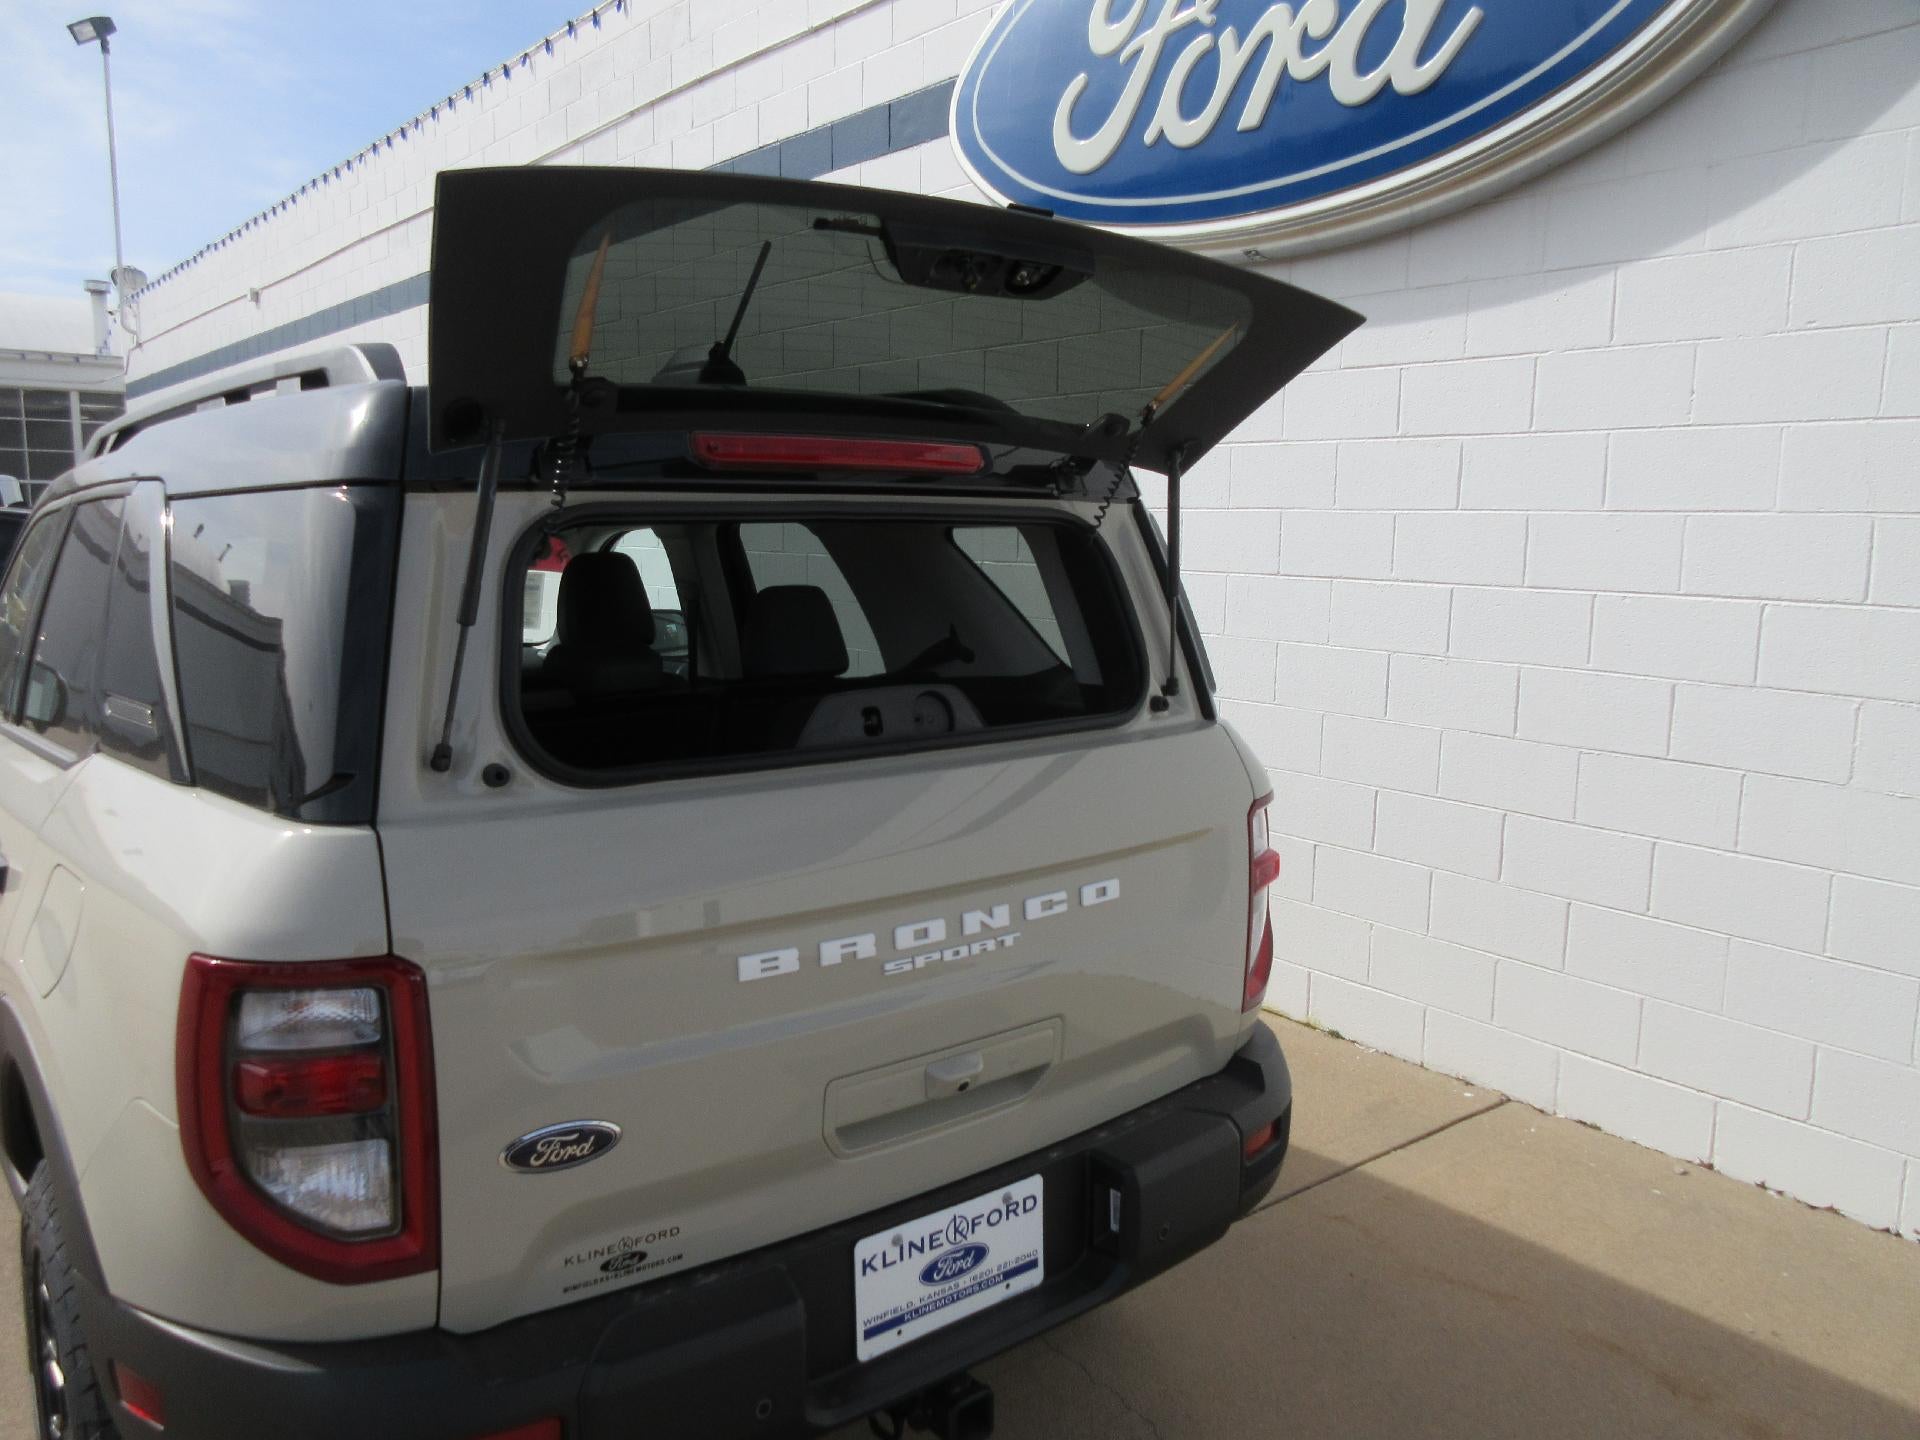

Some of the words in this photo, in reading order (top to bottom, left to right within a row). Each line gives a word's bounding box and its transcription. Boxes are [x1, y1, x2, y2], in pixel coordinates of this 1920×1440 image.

[1052, 0, 1484, 174] Ford
[737, 878, 1121, 982] BRONCO
[882, 931, 1022, 976] SPORT
[530, 1132, 596, 1168] Ford
[563, 1245, 617, 1268] KLINE
[634, 1226, 681, 1248] FORD
[861, 1229, 944, 1277] KLINE
[971, 1194, 1038, 1235] FORD
[933, 1250, 975, 1281] Ford
[903, 1274, 1004, 1322] KLINEMOTORS.COM
[919, 1282, 960, 1304] KANSAS
